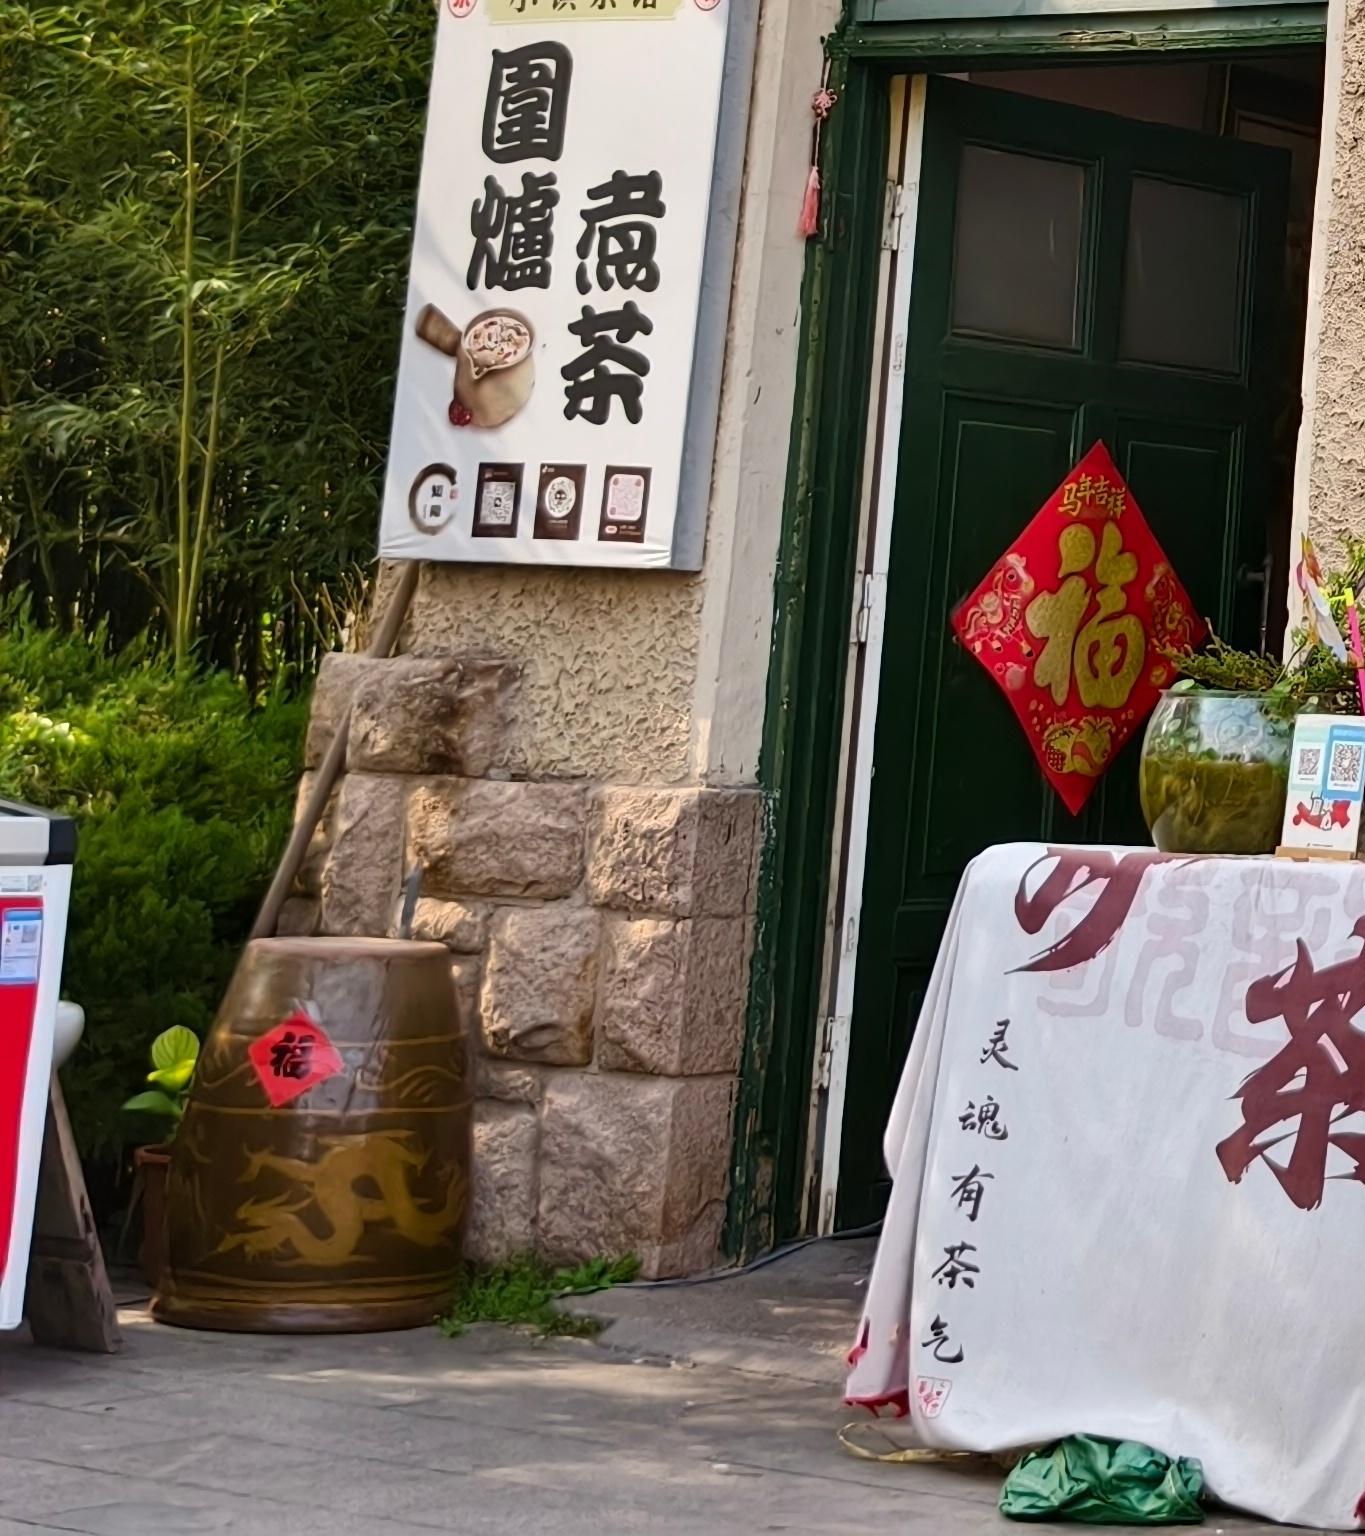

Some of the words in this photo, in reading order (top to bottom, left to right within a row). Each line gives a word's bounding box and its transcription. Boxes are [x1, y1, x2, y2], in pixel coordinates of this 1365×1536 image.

[1025, 520, 1146, 709] 福
[269, 1031, 319, 1080] 福
[920, 1018, 1019, 1363] 灵魂有茶气
